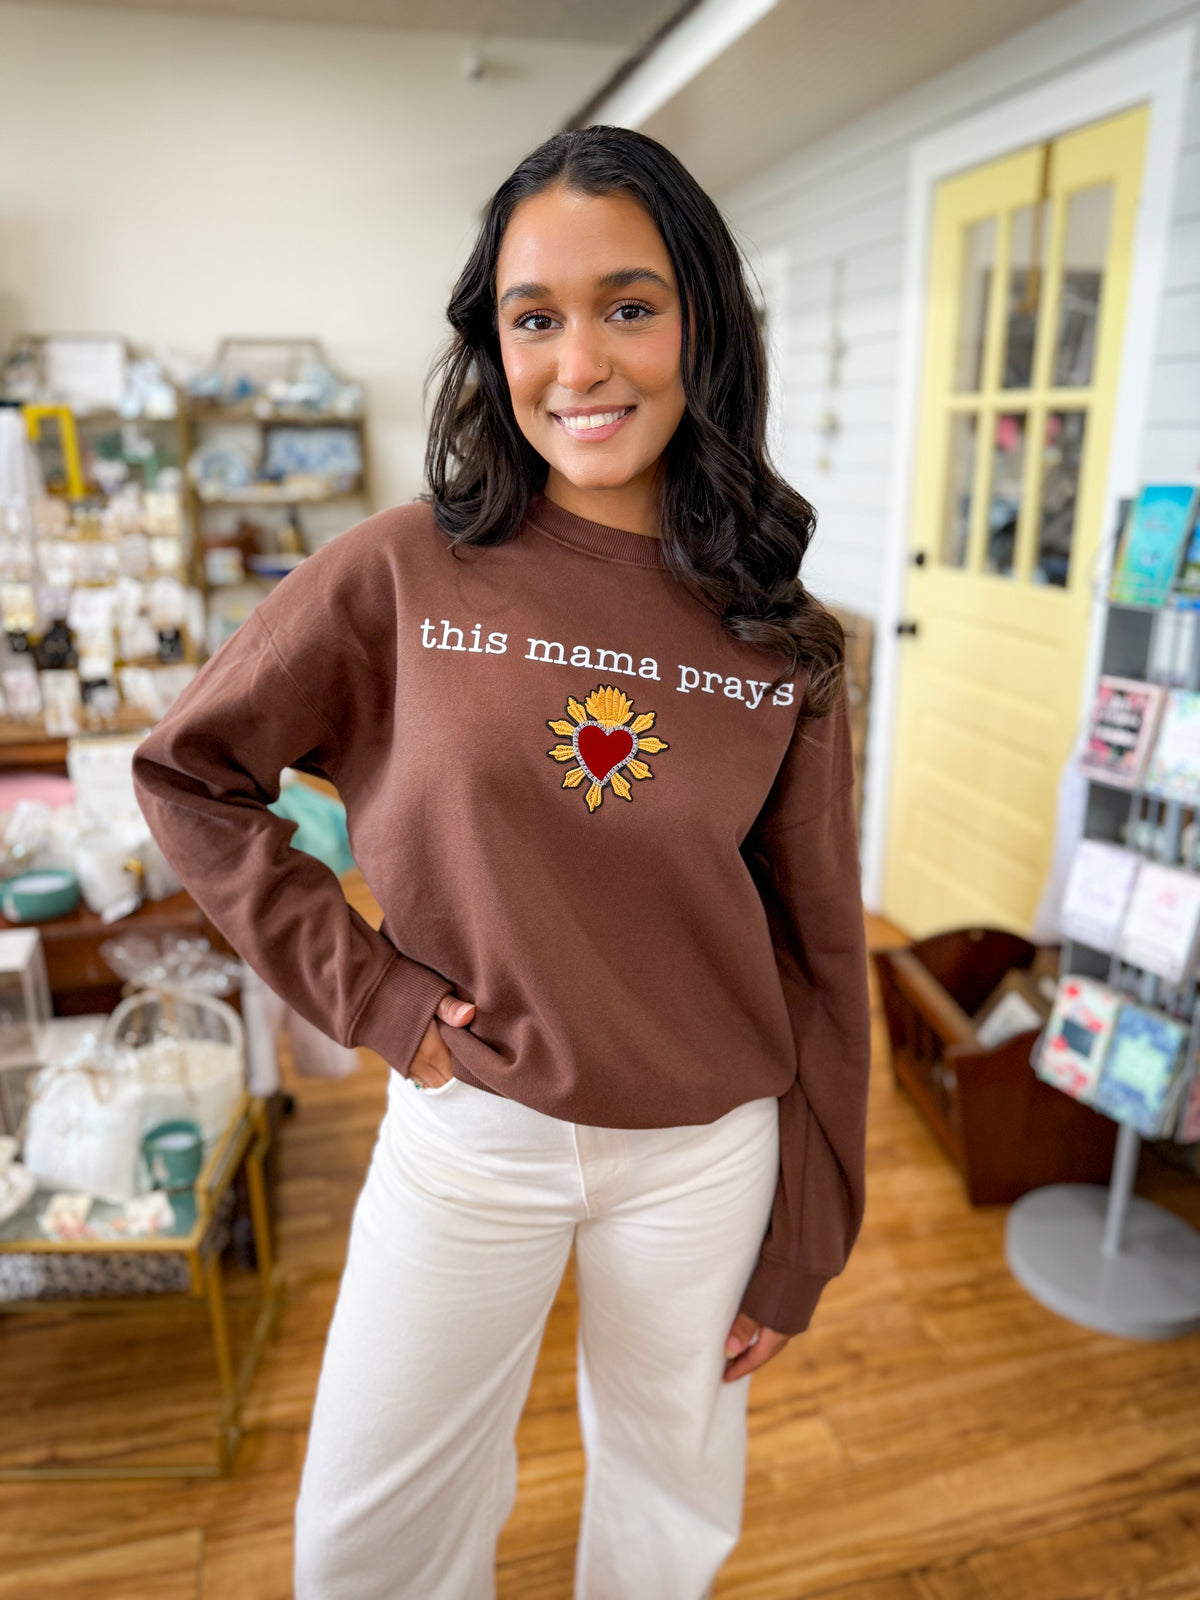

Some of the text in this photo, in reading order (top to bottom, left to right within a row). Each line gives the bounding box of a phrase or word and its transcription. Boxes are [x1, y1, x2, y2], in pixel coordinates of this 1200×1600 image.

[420, 618, 794, 709] this mama prays
